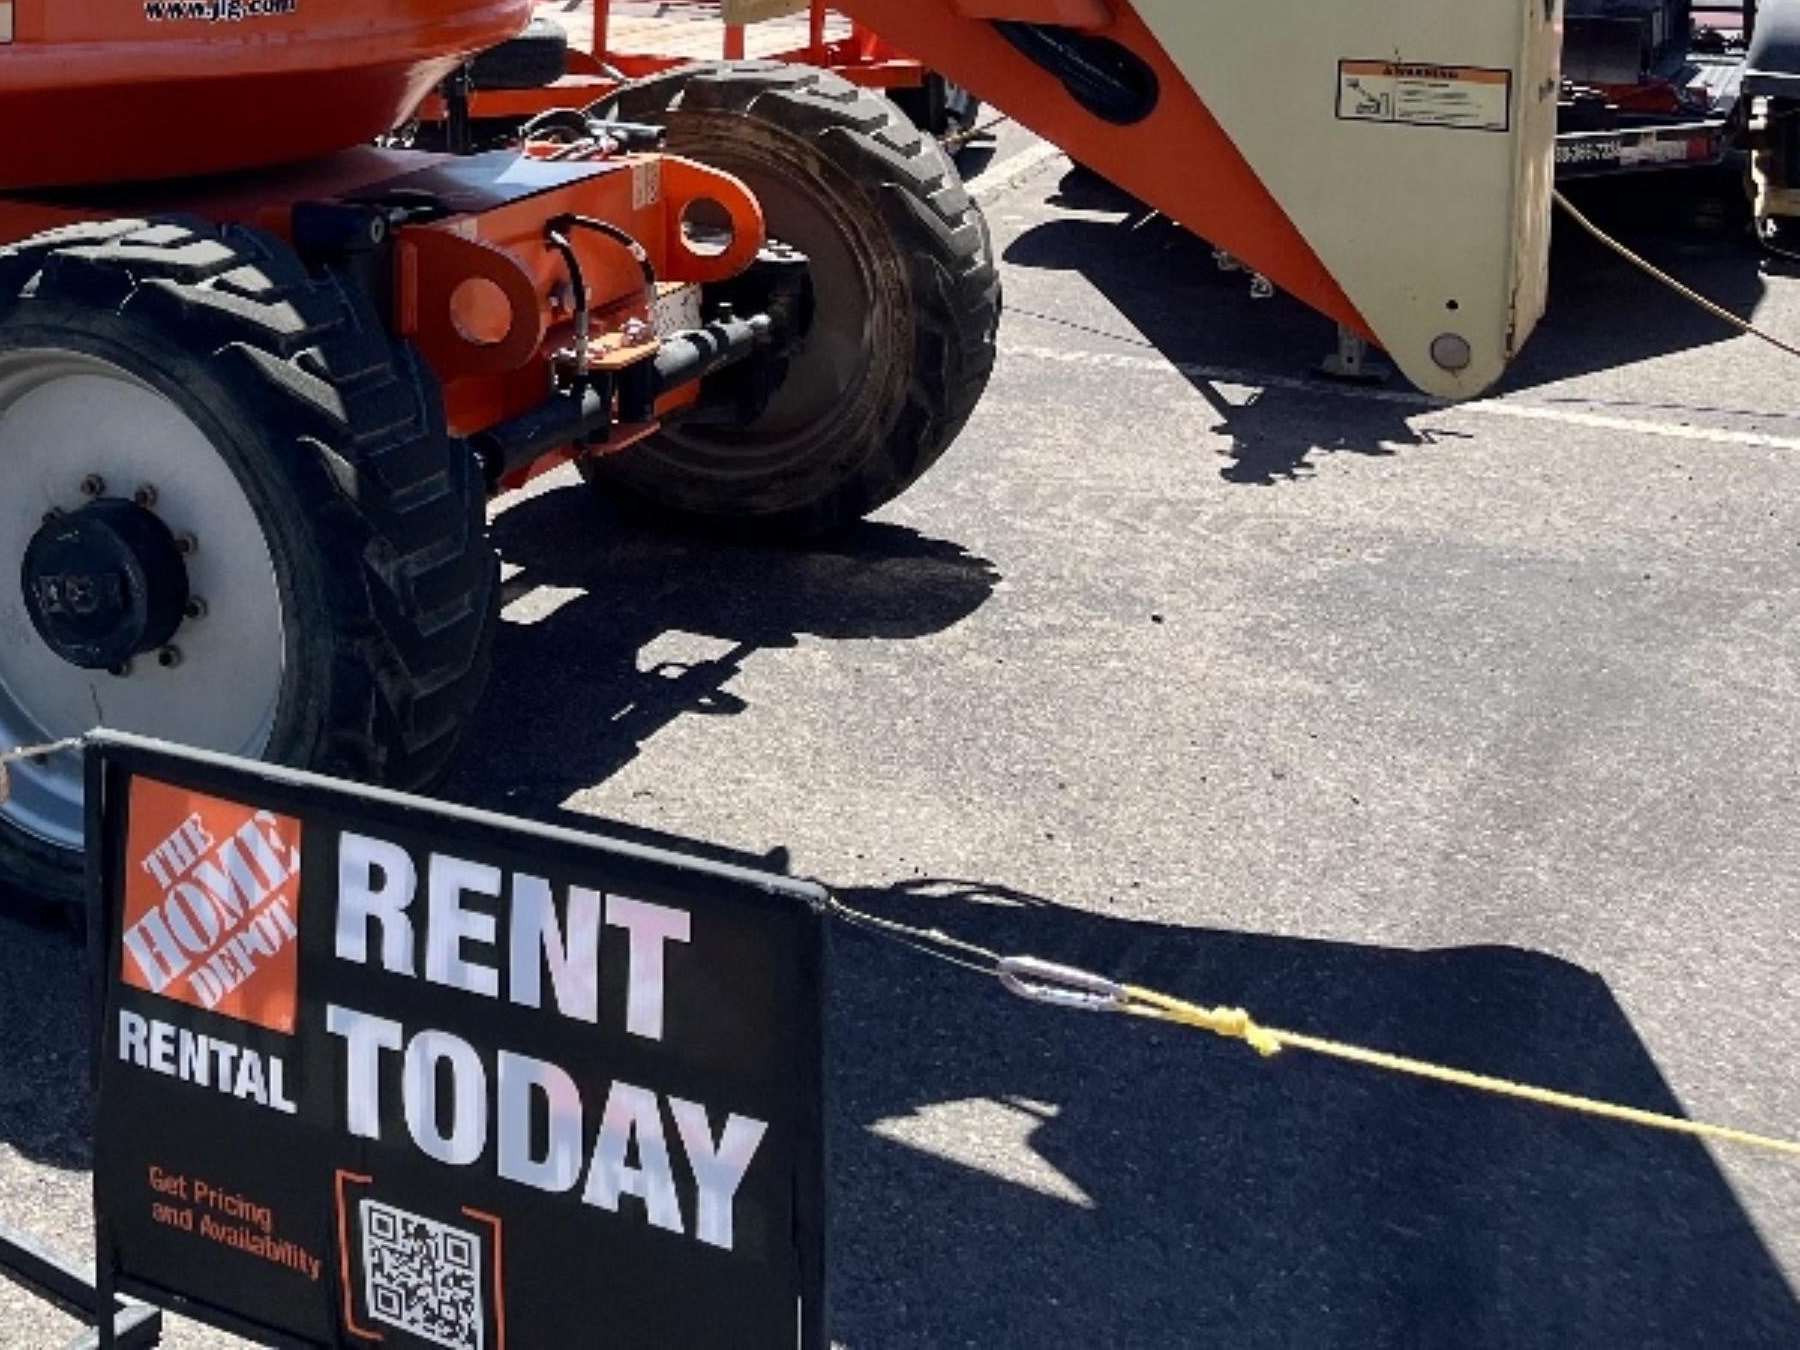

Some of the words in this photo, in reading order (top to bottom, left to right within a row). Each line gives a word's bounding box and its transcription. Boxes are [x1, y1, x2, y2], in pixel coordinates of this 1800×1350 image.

[123, 810, 300, 993] HOME
[141, 811, 215, 889] THE
[188, 895, 296, 1009] DEPOT
[336, 830, 691, 1041] RENT
[119, 1010, 297, 1114] RENTAL
[326, 1003, 768, 1250] TODAY
[149, 1166, 188, 1199] Get
[193, 1179, 272, 1233] Pricing
[152, 1203, 193, 1231] and
[200, 1213, 321, 1282] Availability
